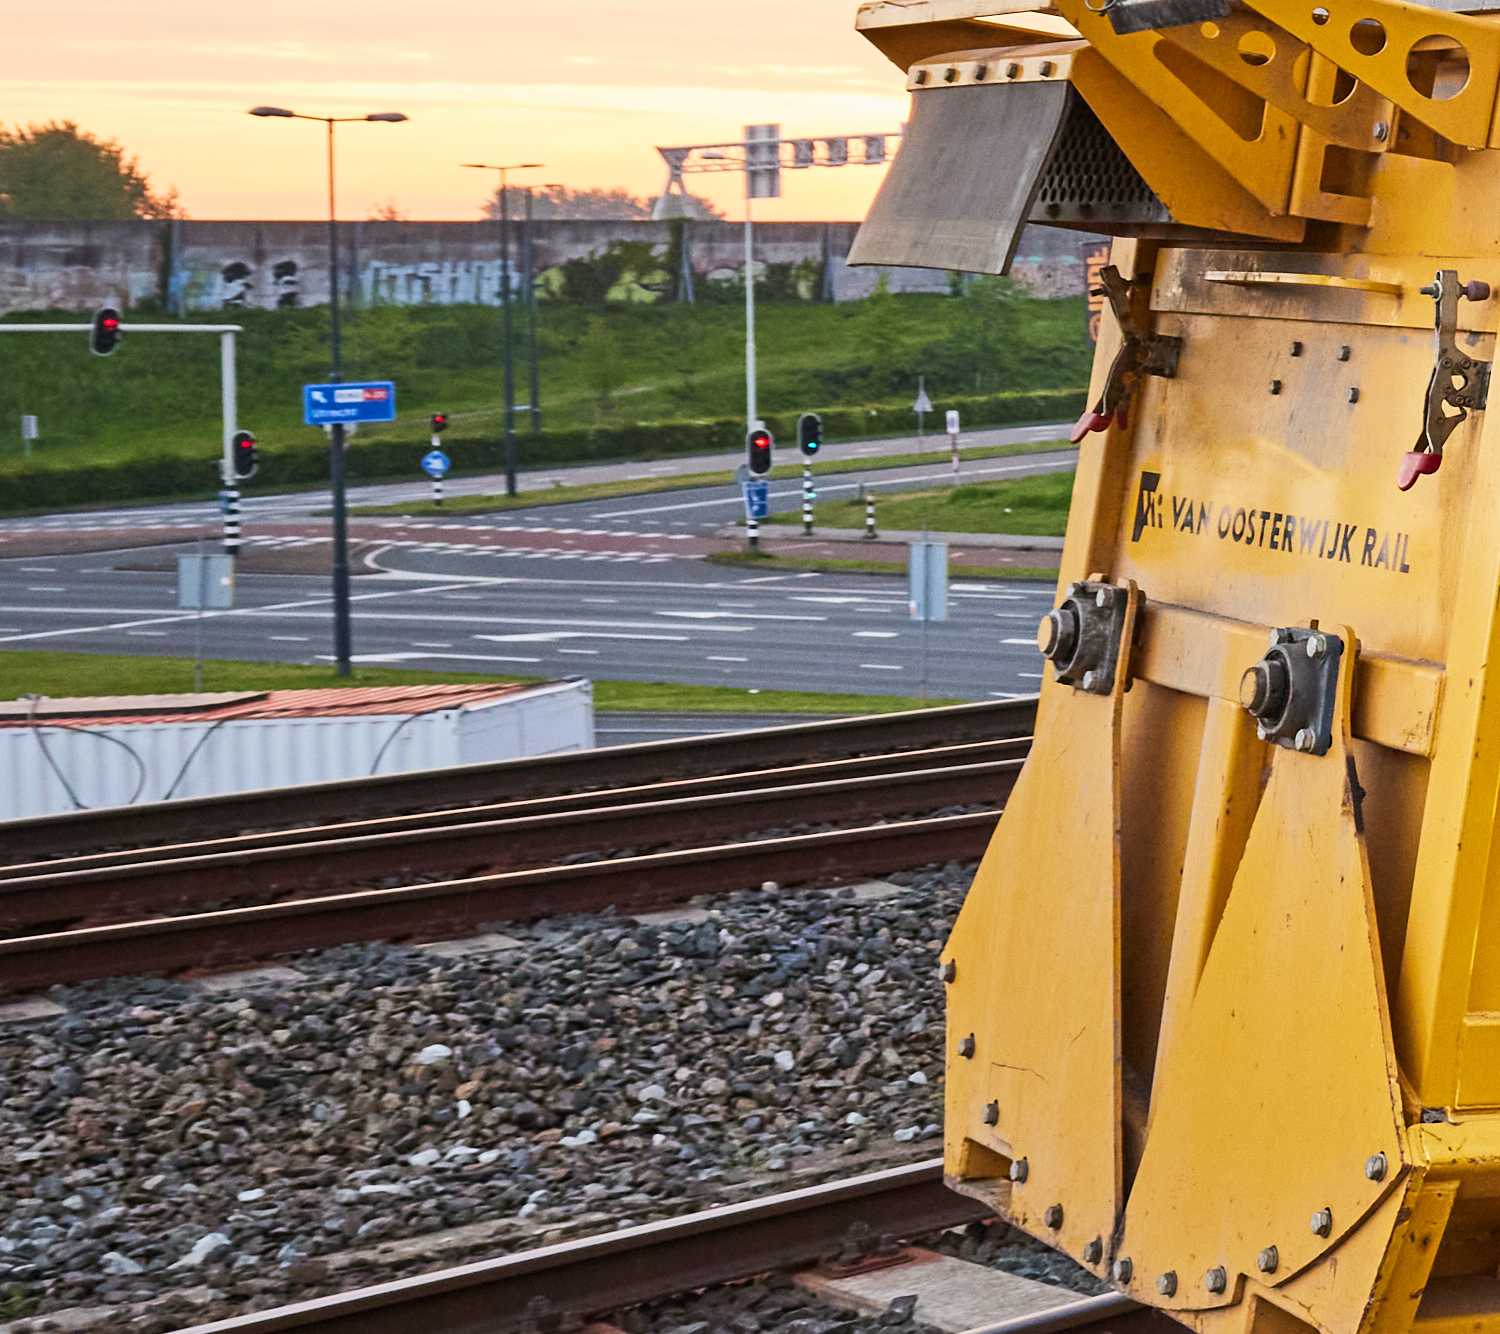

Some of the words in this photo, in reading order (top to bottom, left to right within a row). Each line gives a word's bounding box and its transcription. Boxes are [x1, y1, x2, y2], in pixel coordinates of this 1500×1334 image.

[1172, 496, 1213, 535] VAN
[1217, 504, 1358, 563] OOSTERWIJK
[1360, 528, 1410, 574] RAIL
